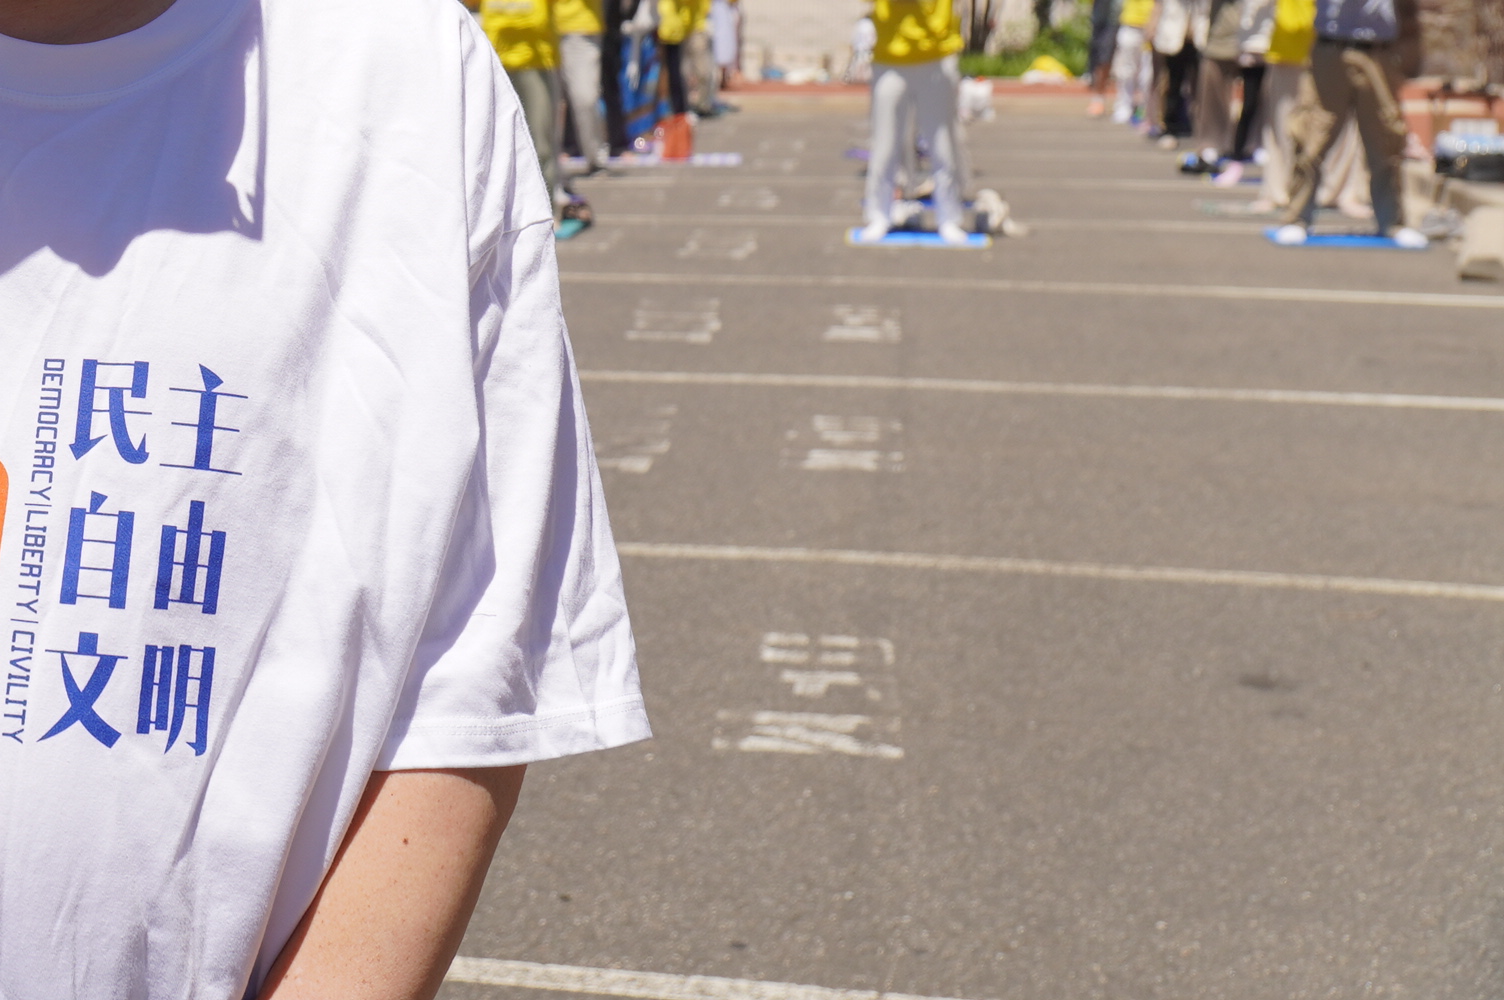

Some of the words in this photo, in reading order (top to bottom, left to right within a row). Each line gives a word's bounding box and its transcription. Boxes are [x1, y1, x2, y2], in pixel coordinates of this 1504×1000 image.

[68, 358, 249, 476] 民主
[59, 490, 227, 616] 自由
[36, 631, 217, 757] 文明
